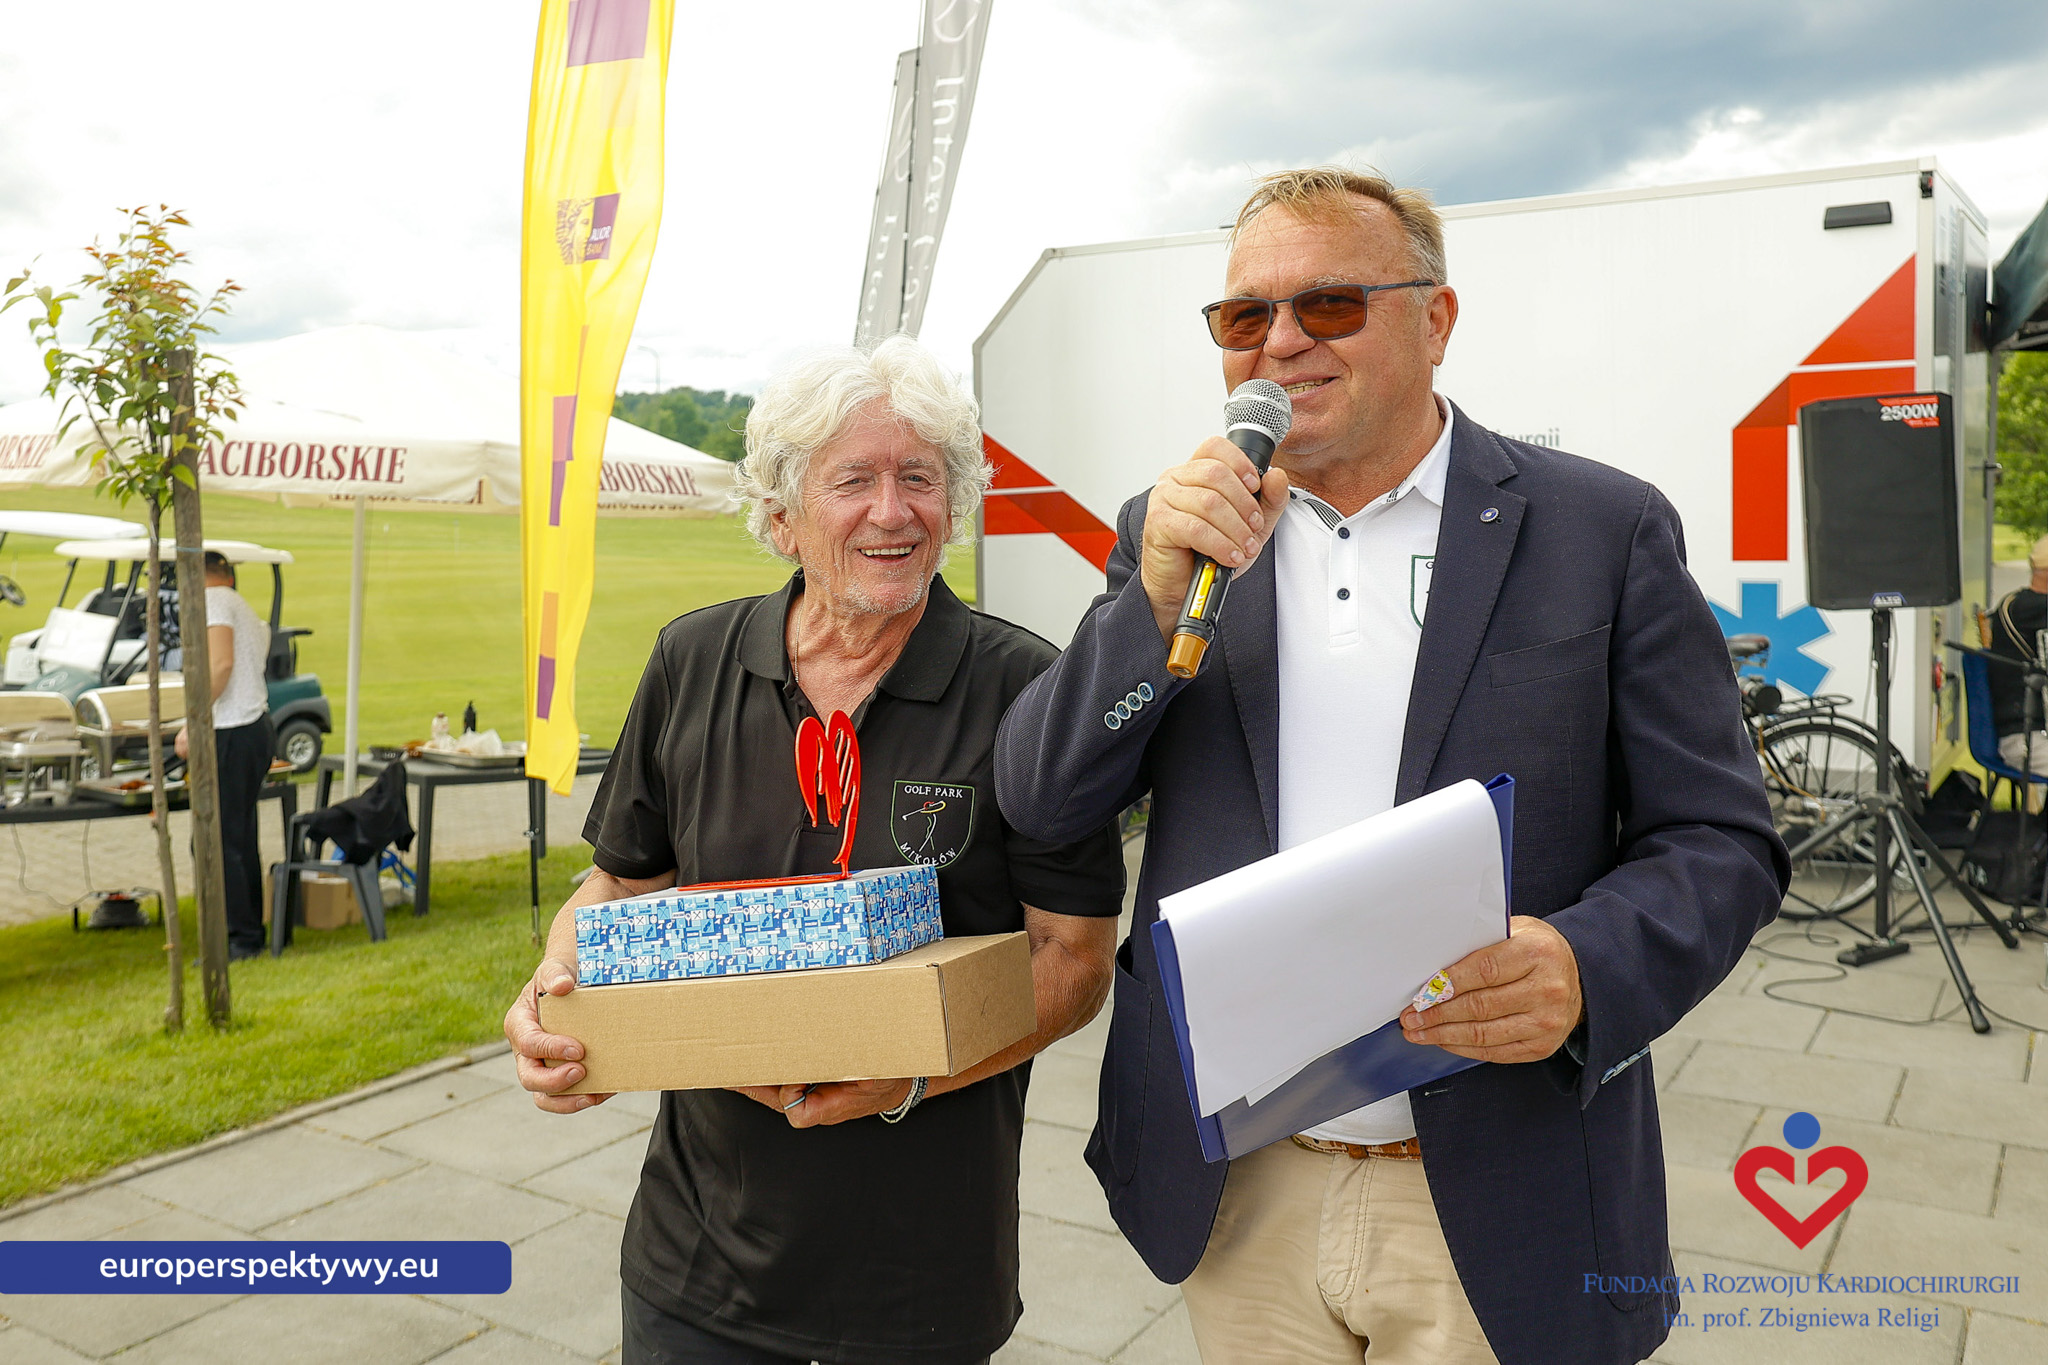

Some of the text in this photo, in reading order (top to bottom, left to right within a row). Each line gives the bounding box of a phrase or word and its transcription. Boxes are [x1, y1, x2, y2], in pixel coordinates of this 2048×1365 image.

[1880, 403, 1939, 422] 2500W
[198, 440, 408, 484] ACIBORSKIE
[599, 461, 702, 496] BORSKIE
[904, 785, 963, 798] GOLF PARK
[900, 842, 957, 866] MIKOŁÓW
